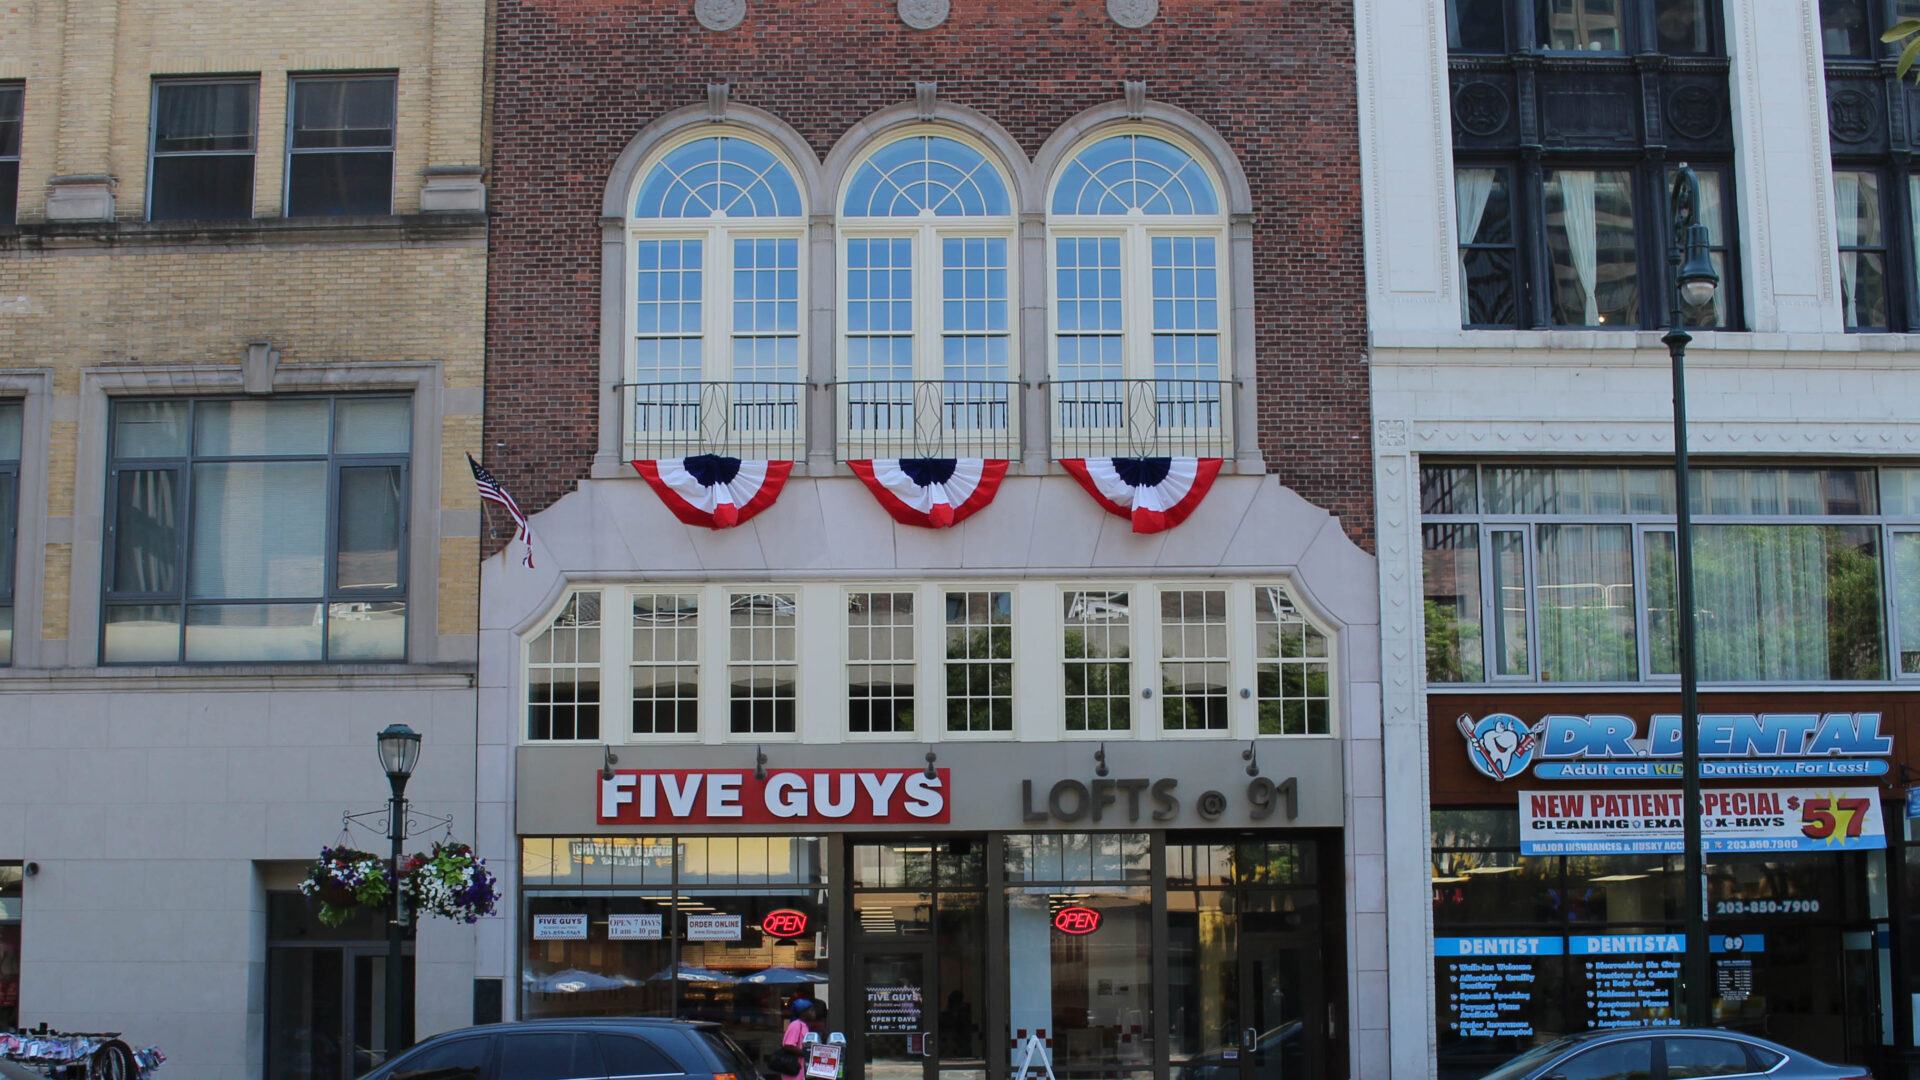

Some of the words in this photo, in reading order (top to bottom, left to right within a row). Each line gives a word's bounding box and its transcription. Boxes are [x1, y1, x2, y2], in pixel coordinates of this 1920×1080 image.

[1541, 714, 1648, 757] DR.
[1649, 712, 1893, 757] DENTAL
[1560, 764, 1609, 775] Adult
[1614, 764, 1648, 775] and
[1829, 761, 1870, 773] Less!
[601, 773, 744, 817] FIVE
[764, 771, 944, 818] GUYS
[1022, 777, 1180, 823] LOFTS
[1196, 790, 1227, 822] @
[1247, 776, 1299, 821] 91
[1531, 795, 1584, 818] NEW
[1590, 793, 1683, 817] PATIENT
[1532, 819, 1630, 830] CLEANING
[1644, 818, 1684, 828] EXA
[1715, 817, 1785, 828] X-RAYS
[1533, 842, 1564, 853] MAJOR
[1565, 841, 1623, 852] INSURANCES
[1623, 843, 1631, 851] &
[1632, 841, 1662, 851] HUSKY
[1727, 839, 1799, 850] 203.850.7900
[1716, 899, 1820, 915] 203-850-7900
[689, 920, 713, 928] ORDER
[714, 920, 740, 928] ONLINE
[763, 914, 808, 932] OPEN
[1055, 912, 1099, 929] OPEN
[611, 927, 618, 935] 11
[648, 929, 660, 937] pm
[1460, 938, 1540, 955] DENTIST
[1587, 936, 1681, 953] DENTISTA
[1724, 936, 1743, 950] 89
[1496, 963, 1532, 971] Welcome
[868, 993, 890, 1001] FIVE
[891, 993, 919, 1001] GUYS
